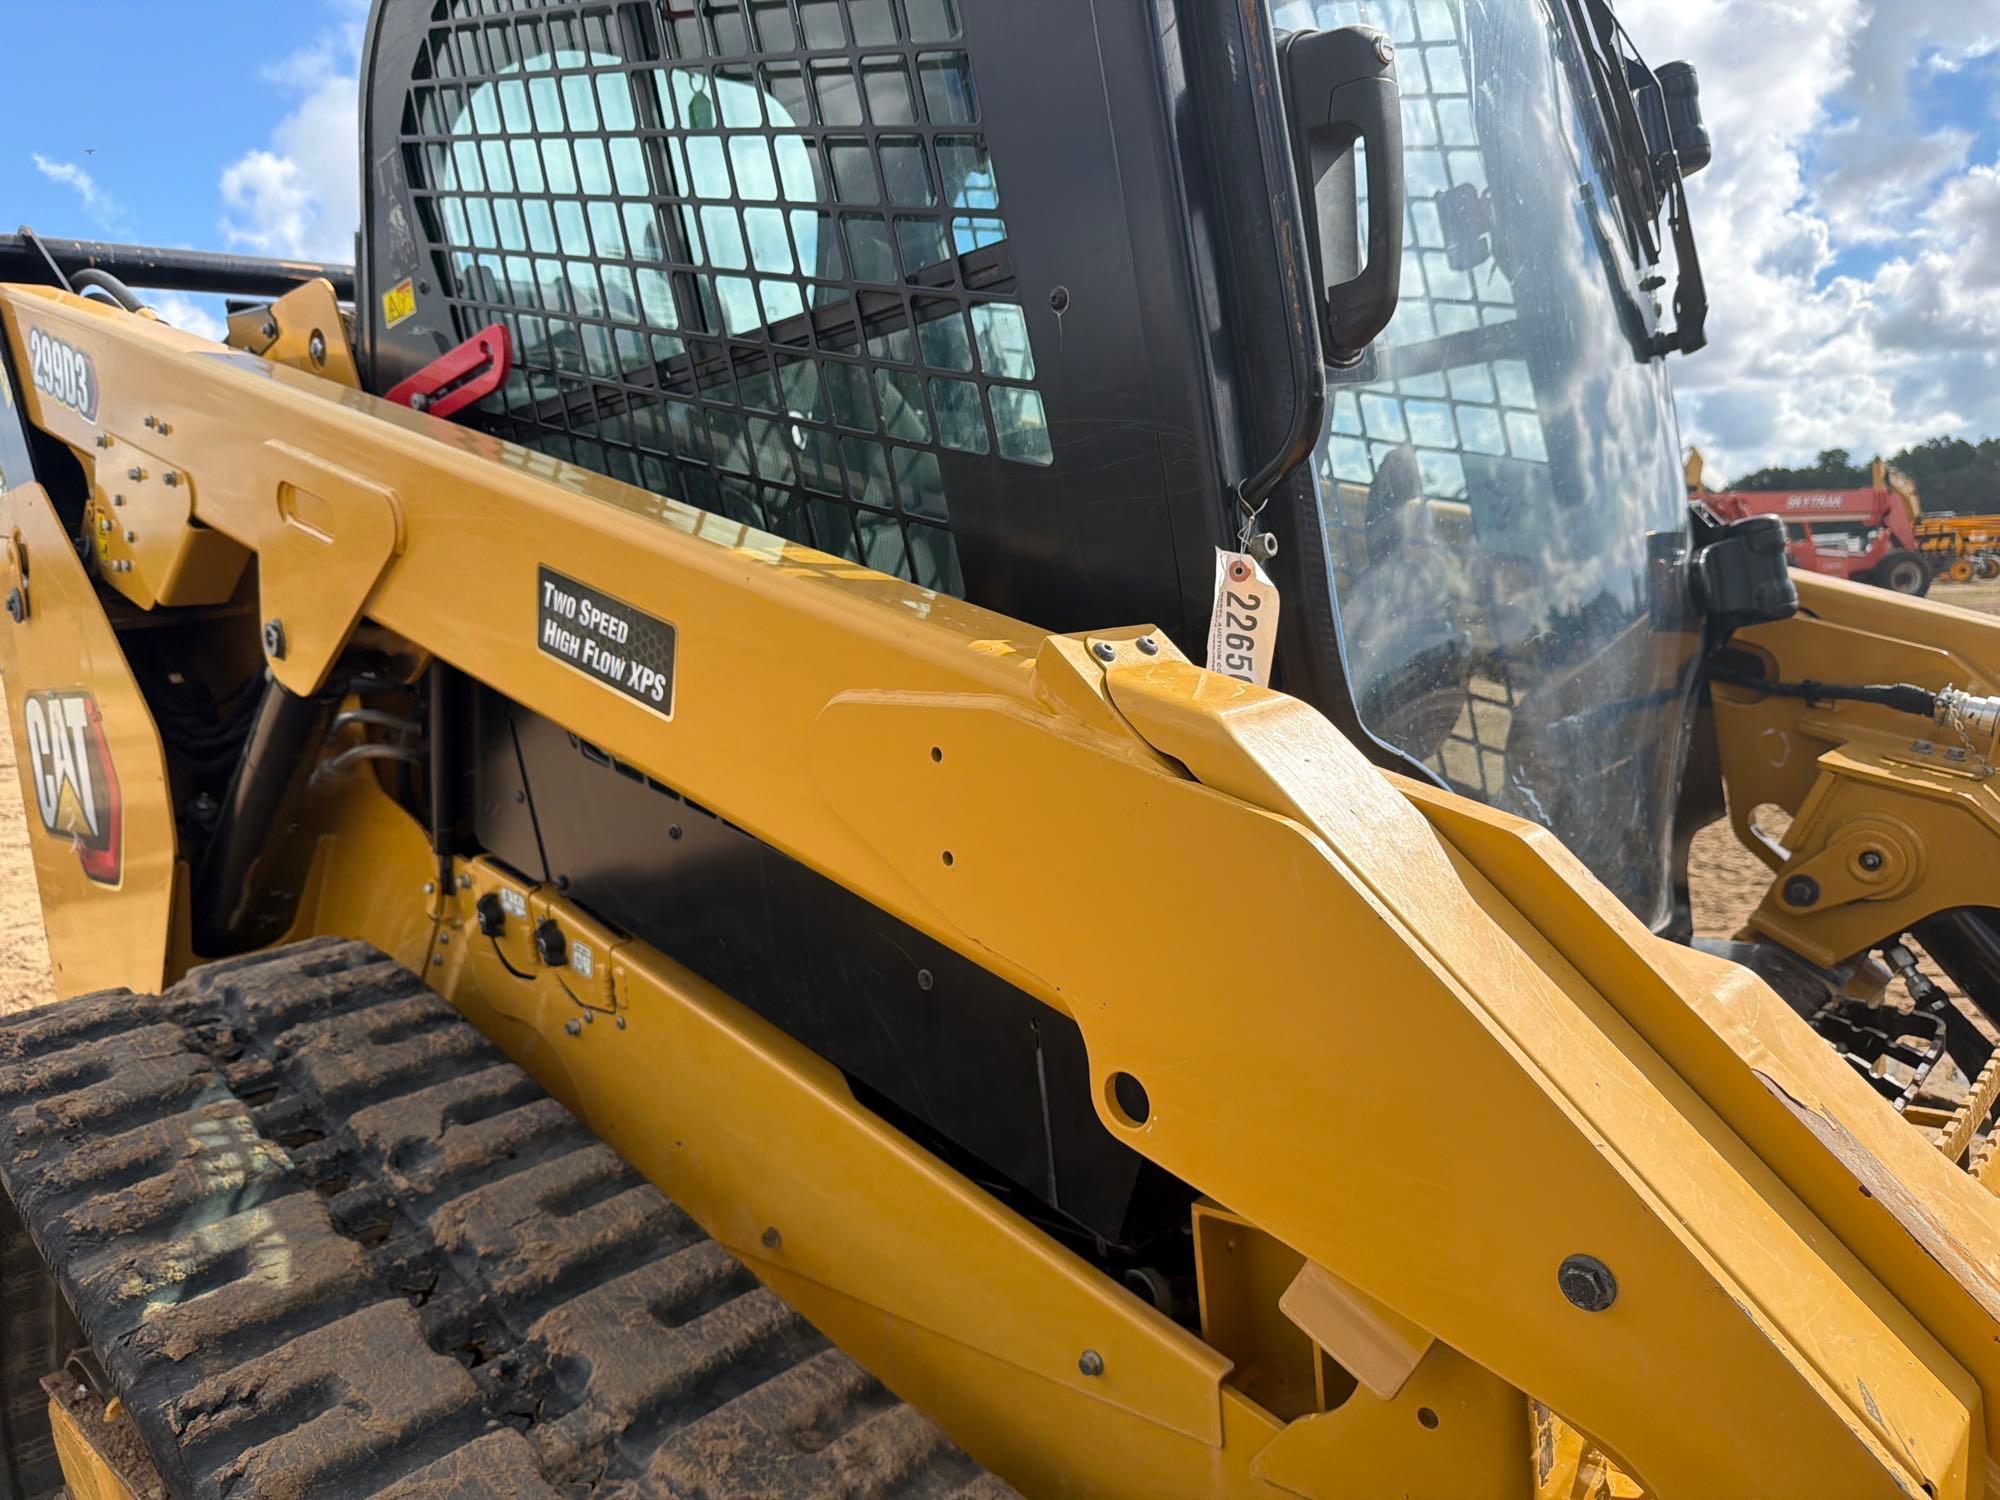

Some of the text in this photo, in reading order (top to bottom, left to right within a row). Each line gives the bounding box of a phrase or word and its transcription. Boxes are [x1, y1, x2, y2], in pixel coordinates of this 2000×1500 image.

[30, 329, 89, 414] 299D3
[627, 661, 667, 702] XPS
[26, 698, 99, 836] CAT
